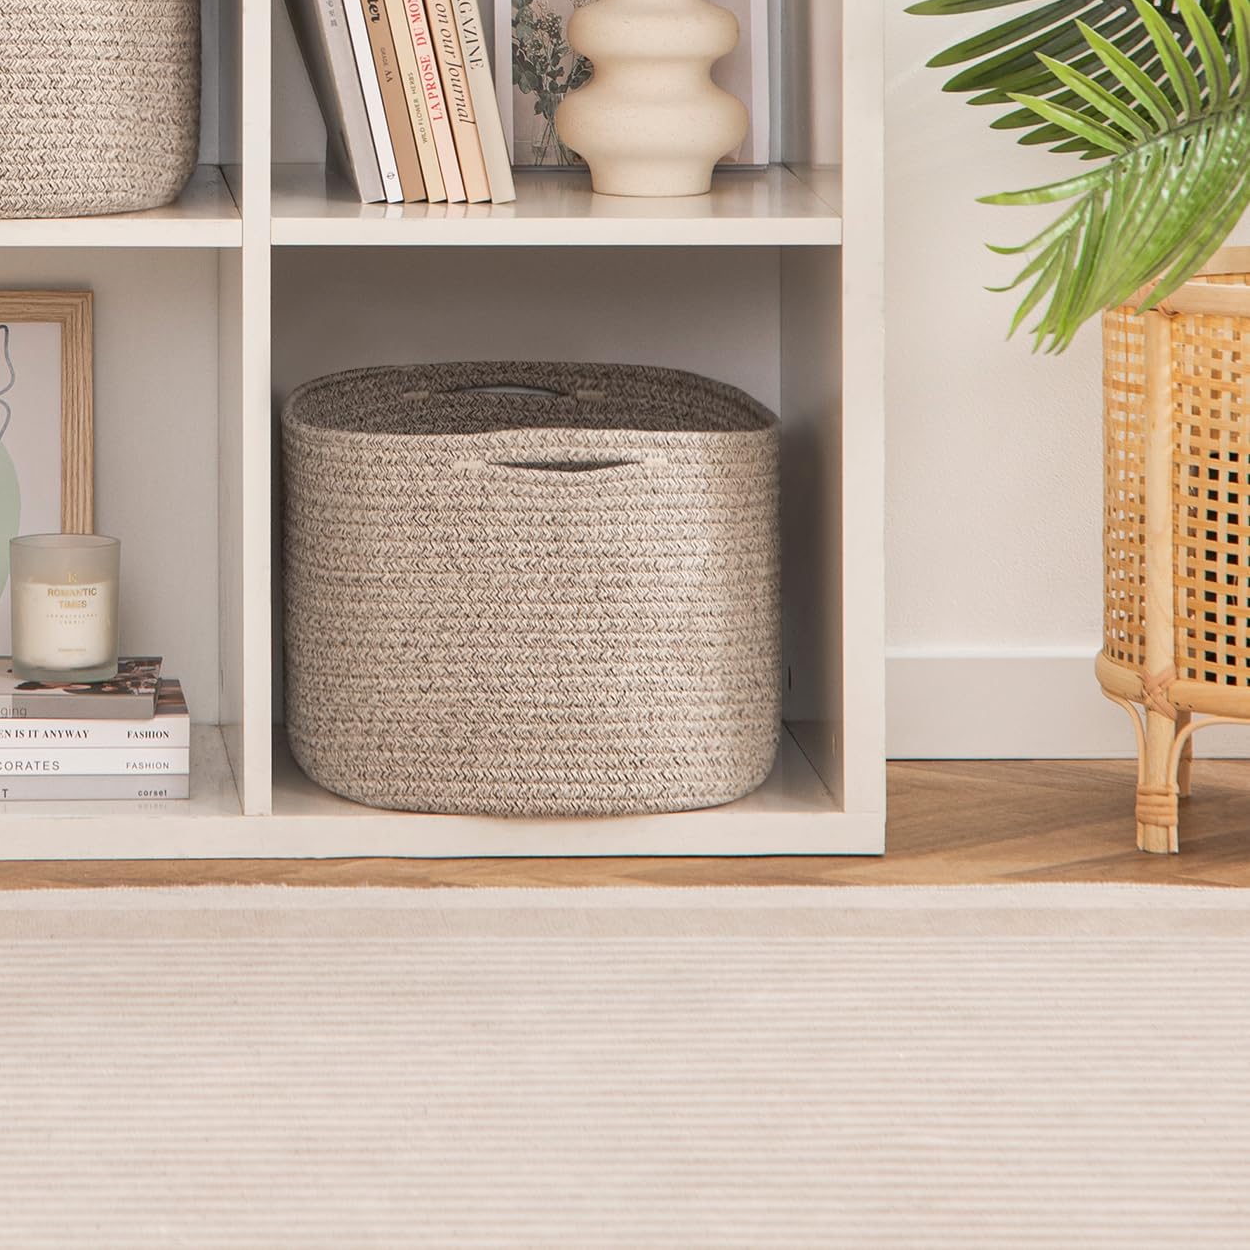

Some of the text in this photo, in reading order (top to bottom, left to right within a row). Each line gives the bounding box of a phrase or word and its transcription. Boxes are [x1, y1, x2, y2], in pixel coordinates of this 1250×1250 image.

[435, 2, 448, 23] on
[414, 27, 427, 46] DU
[440, 28, 456, 58] our
[419, 54, 439, 100] PROSE
[448, 61, 476, 125] Journal
[407, 72, 428, 144] WILD FLOWER HERBS
[431, 102, 443, 121] LA
[47, 588, 98, 597] ROMANTIC
[59, 600, 87, 609] TIMES
[15, 729, 25, 739] IS
[28, 729, 39, 739] IT
[42, 729, 90, 739] ANYWAY
[127, 730, 170, 739] FASHION
[126, 761, 170, 769] FASHION
[138, 789, 168, 797] corset
